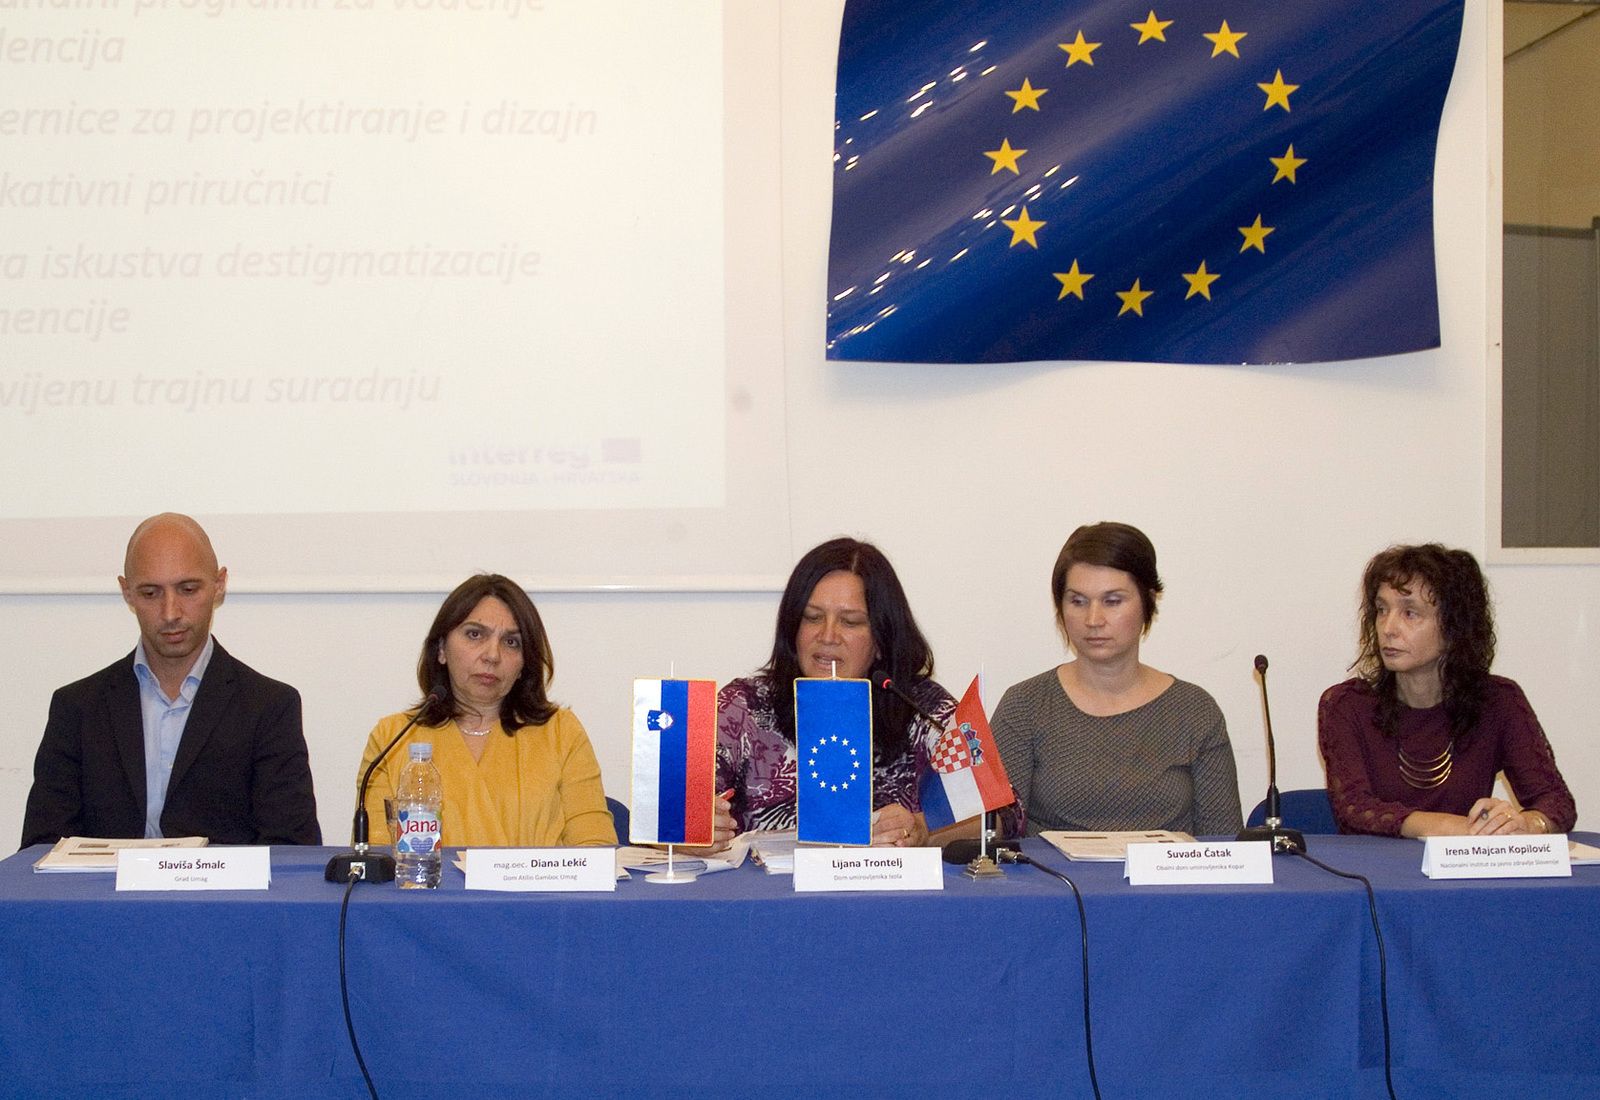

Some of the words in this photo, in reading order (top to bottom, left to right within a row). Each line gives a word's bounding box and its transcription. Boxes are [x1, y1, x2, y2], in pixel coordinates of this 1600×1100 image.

[132, 108, 176, 135] za
[187, 100, 447, 143] projektiranje
[459, 101, 470, 134] i
[481, 100, 599, 143] dizajn
[0, 171, 134, 206] kativni
[145, 169, 334, 213] priručnici
[41, 242, 203, 279] iskustva
[216, 242, 542, 285] destigmatizacije
[131, 371, 252, 413] trajnu
[265, 368, 441, 411] suradnju
[1167, 849, 1202, 859] Suvada
[1204, 847, 1232, 858] Čatak
[1445, 847, 1469, 856] Irena
[1472, 846, 1507, 857] Majcan
[1508, 843, 1551, 855] Kopilović
[158, 859, 193, 870] Slaviša
[195, 858, 226, 870] Šmalc
[530, 858, 559, 868] Diana
[562, 857, 587, 867] Lekić
[832, 860, 861, 869] Lijana
[863, 858, 903, 869] Trontelj
